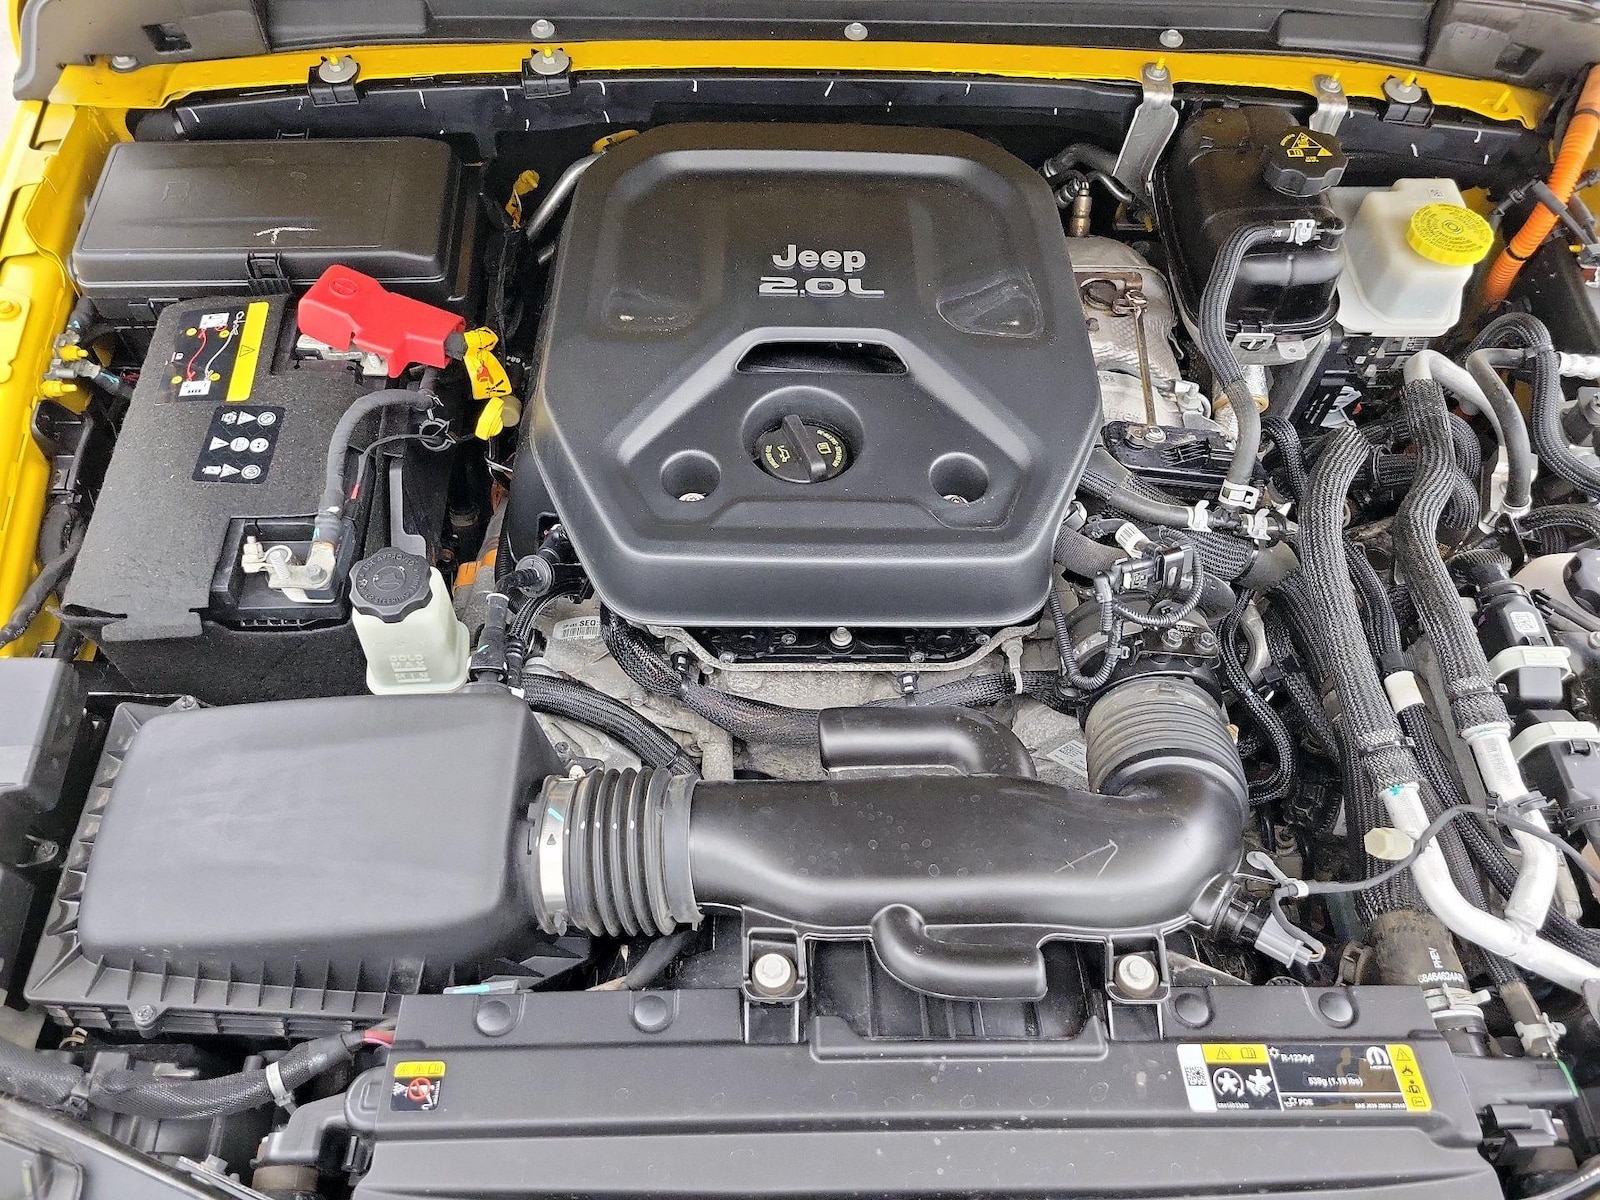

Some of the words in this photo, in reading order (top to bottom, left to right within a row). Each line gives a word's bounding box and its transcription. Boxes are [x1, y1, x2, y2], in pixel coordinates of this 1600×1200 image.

[772, 244, 866, 275] Jeep
[758, 276, 885, 298] 2.0L
[377, 553, 415, 566] APPROVED
[389, 653, 425, 662] COLD
[390, 661, 427, 670] MAX
[395, 672, 431, 681] MIN
[1427, 946, 1444, 969] PHEV
